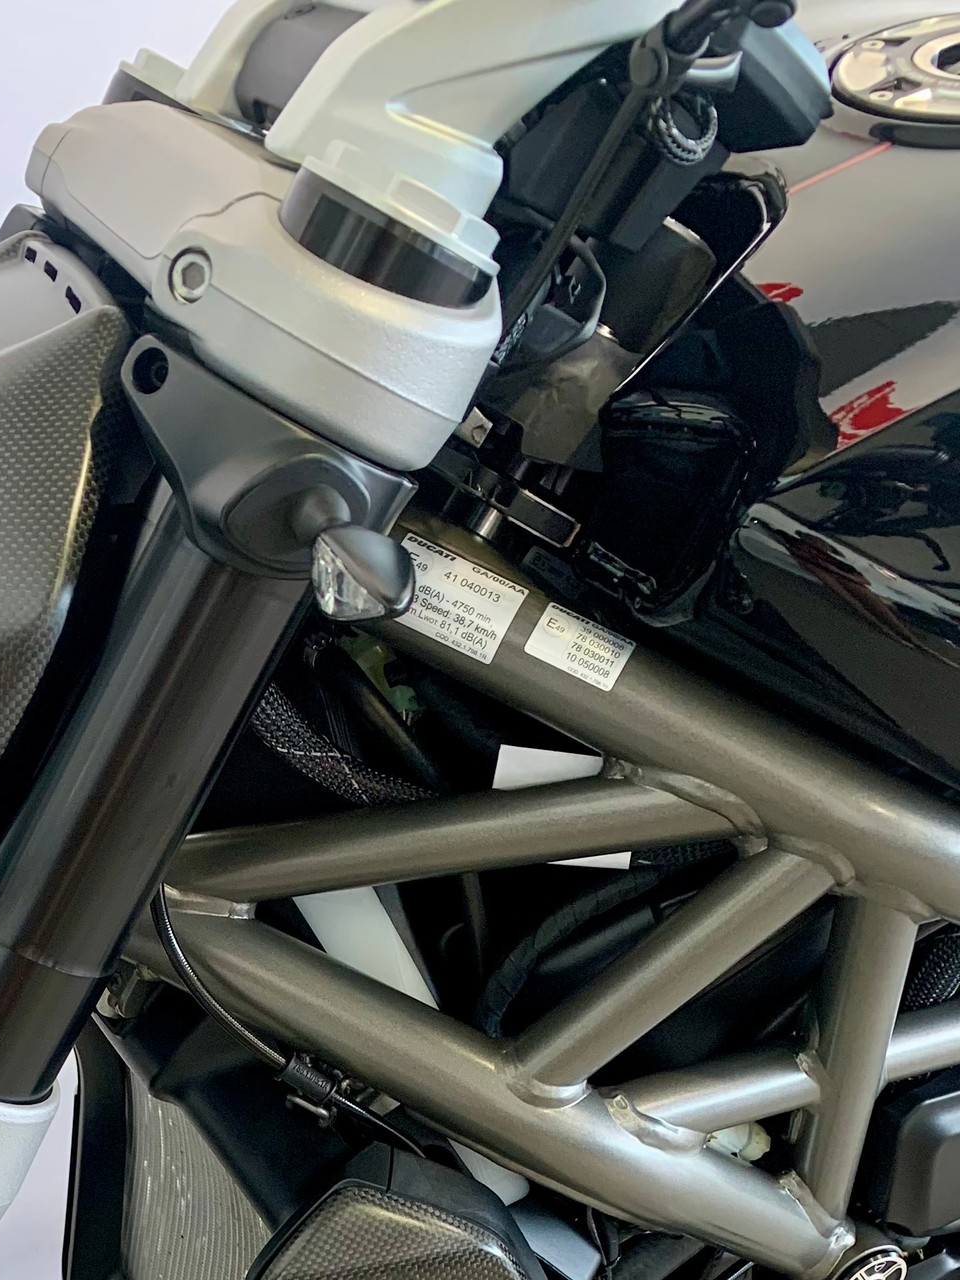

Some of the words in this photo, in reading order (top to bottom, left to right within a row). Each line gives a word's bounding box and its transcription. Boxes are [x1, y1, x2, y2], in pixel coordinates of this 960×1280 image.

[406, 535, 457, 562] DUCATI
[472, 566, 526, 596] GA/00/AA
[418, 584, 445, 604] dB(A)
[451, 600, 475, 616] 4750
[444, 571, 458, 583] 41
[460, 578, 501, 603] 040013
[420, 598, 453, 619] Speed:
[474, 623, 498, 641] km/h
[551, 604, 590, 625] DUCATI
[460, 631, 488, 650] dB(A)
[575, 633, 589, 644] 78
[588, 639, 621, 660] 030010
[565, 652, 578, 663] 10
[577, 658, 611, 680] 050008
[571, 642, 583, 653] 78
[583, 649, 616, 669] 030011
